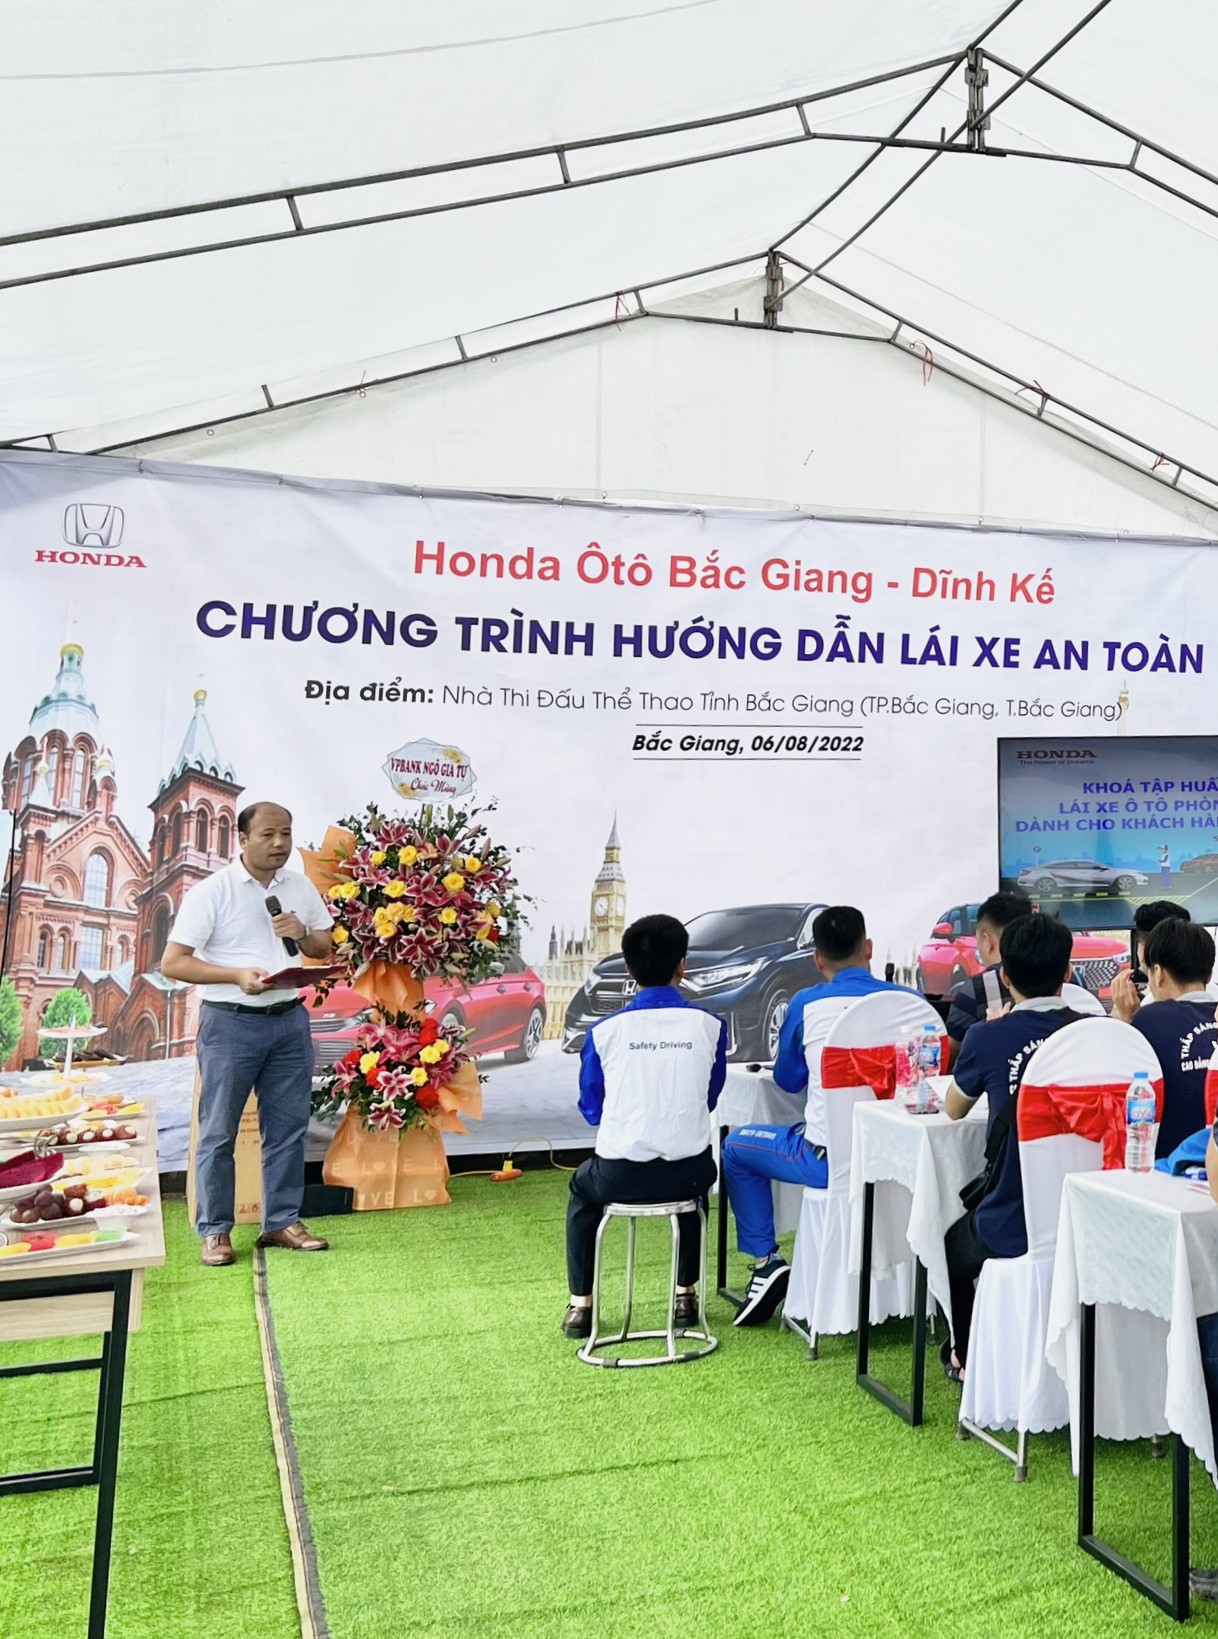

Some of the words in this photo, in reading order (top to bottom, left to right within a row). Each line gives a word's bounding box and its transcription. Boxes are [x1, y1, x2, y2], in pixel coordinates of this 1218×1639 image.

[34, 549, 148, 568] HONDA
[414, 539, 561, 582] Honda
[577, 541, 653, 587] Ôtô
[669, 549, 747, 591] Bắc
[761, 557, 873, 604] Giang
[887, 581, 899, 589] -
[911, 567, 996, 603] Dĩnh
[1009, 567, 1056, 605] Kế
[196, 600, 438, 649] CHƯƠNG
[454, 607, 595, 657] TRÌNH
[612, 615, 783, 661] HƯỚNG
[796, 614, 885, 664] DẪN
[900, 624, 960, 667] LÁI
[971, 636, 1021, 669] XE
[1032, 639, 1089, 671] AN
[1102, 633, 1204, 674] TOÀN
[304, 679, 351, 706] Địa
[359, 676, 434, 704] điểm:
[442, 685, 493, 706] Nhà
[499, 687, 530, 707] Thi
[537, 688, 585, 709] Đấu
[592, 686, 632, 710] Thể
[639, 692, 694, 711] Thao
[700, 690, 739, 712] Tỉnh
[745, 690, 786, 712] Bắc
[791, 694, 854, 718] Giang
[860, 695, 929, 717] (TP.Bắc
[934, 697, 999, 720] Giang,
[1005, 698, 1055, 718] T.Bắc
[1060, 700, 1123, 722] Giang)
[632, 730, 672, 752] Bắc
[679, 735, 744, 756] Giang,
[750, 735, 865, 753] 06/08/2022
[1016, 750, 1098, 759] HONDA
[390, 758, 421, 774] VPBANK
[422, 758, 439, 776] NGÔ
[440, 763, 454, 778] GIA
[1083, 778, 1135, 794] KHOÁ
[1140, 778, 1175, 795] TẬP
[1059, 800, 1090, 815] LÁI
[1096, 801, 1119, 813] XE
[1125, 797, 1139, 813] Ô
[1144, 797, 1168, 813] TÔ
[1015, 815, 1070, 832] DÀNH
[1076, 818, 1116, 831] CHO
[1121, 813, 1185, 830] KHÁCH
[629, 1042, 657, 1051] Safety
[660, 1041, 693, 1050] Driving
